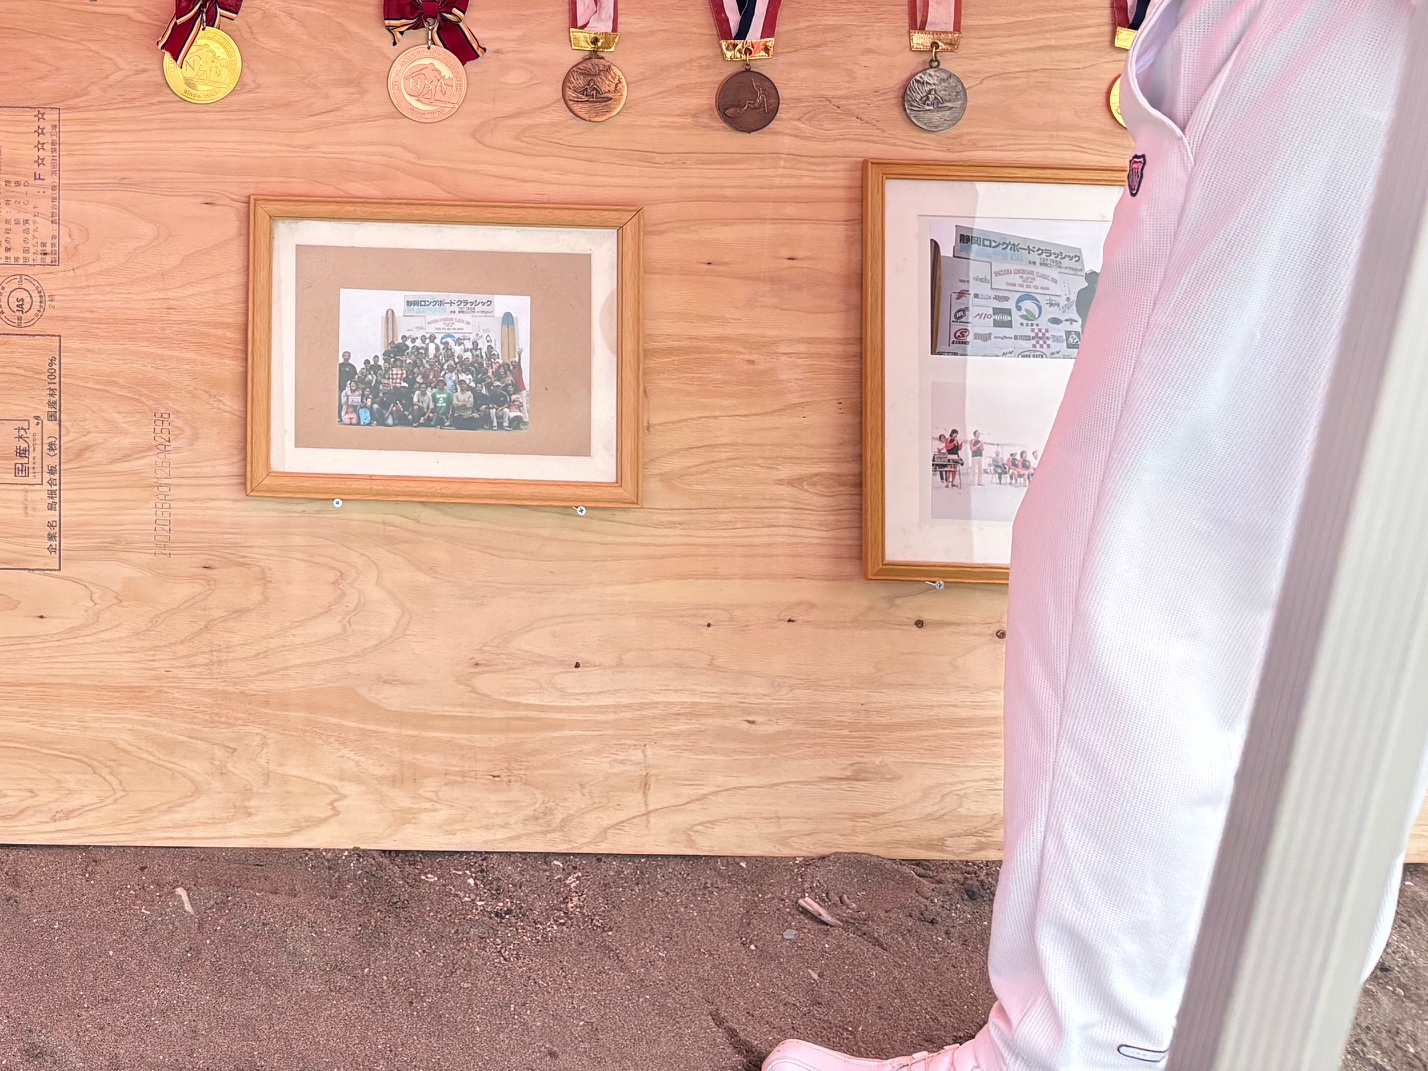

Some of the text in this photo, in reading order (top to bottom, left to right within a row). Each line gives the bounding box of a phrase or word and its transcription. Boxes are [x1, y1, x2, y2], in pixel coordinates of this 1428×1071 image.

[16, 297, 24, 314] JAS
[13, 425, 30, 478] 国産材
[46, 519, 59, 555] 企業名
